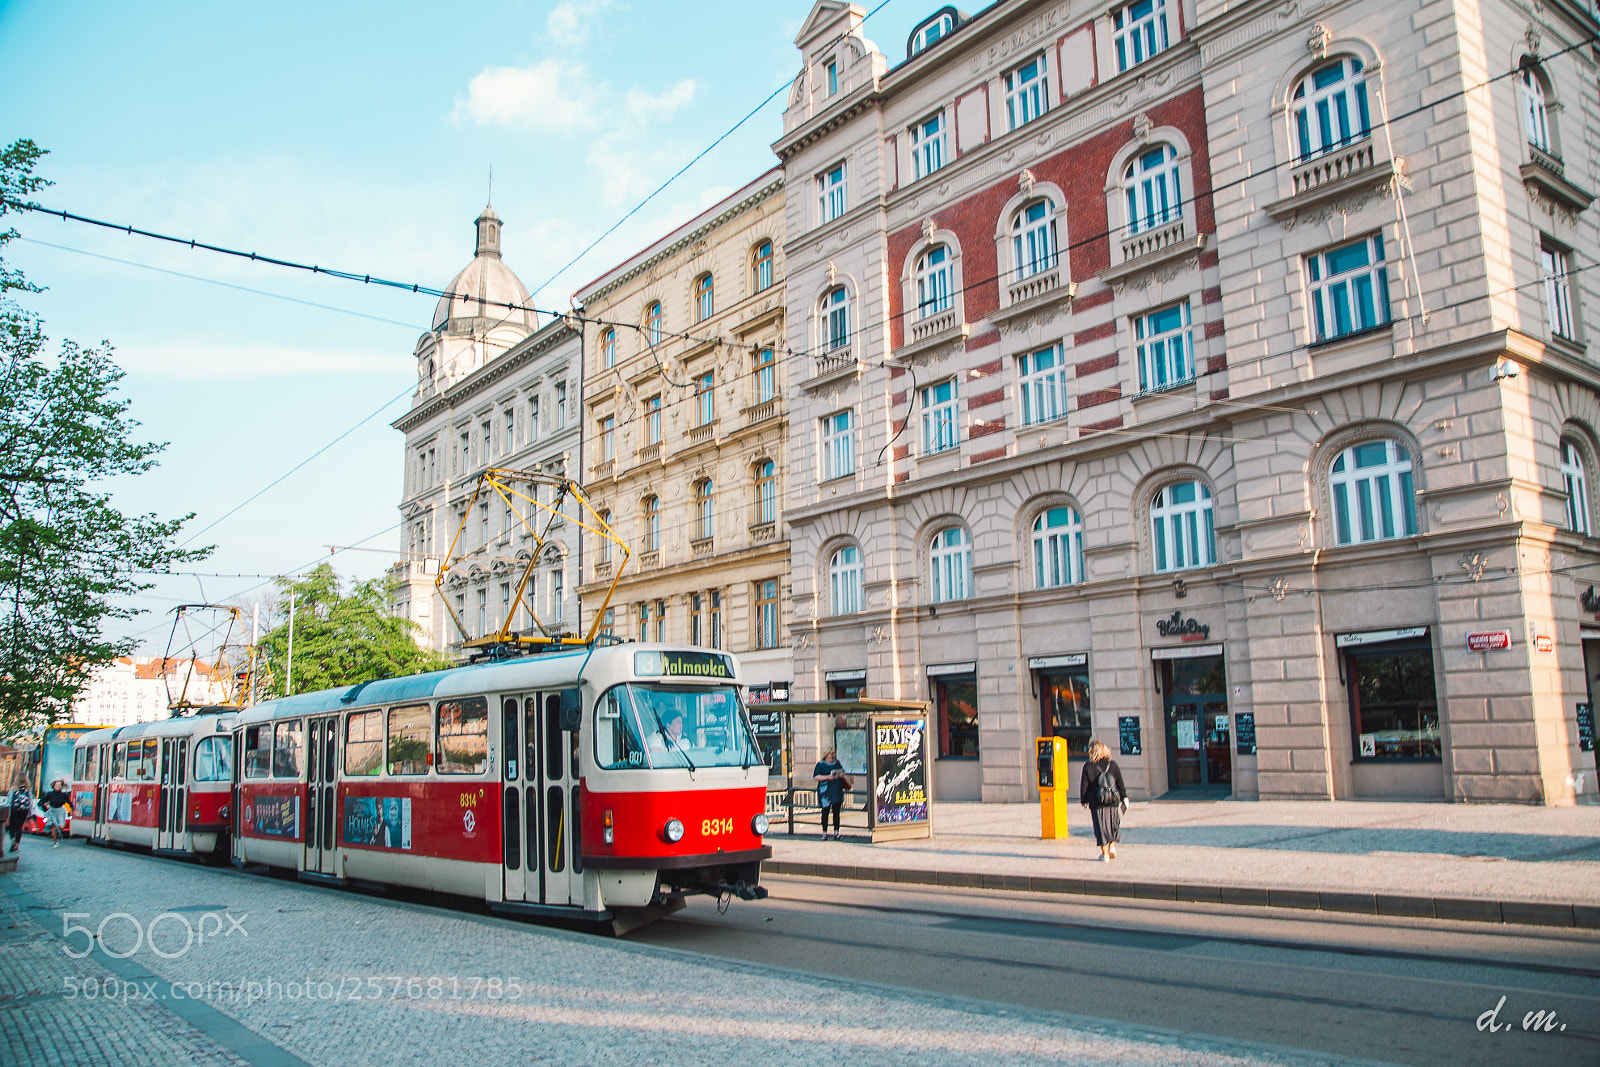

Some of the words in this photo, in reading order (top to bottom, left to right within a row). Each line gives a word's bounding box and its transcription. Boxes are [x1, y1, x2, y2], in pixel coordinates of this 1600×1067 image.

[876, 727, 912, 746] ELVIS
[460, 792, 477, 808] 8314
[701, 817, 734, 836] 8314
